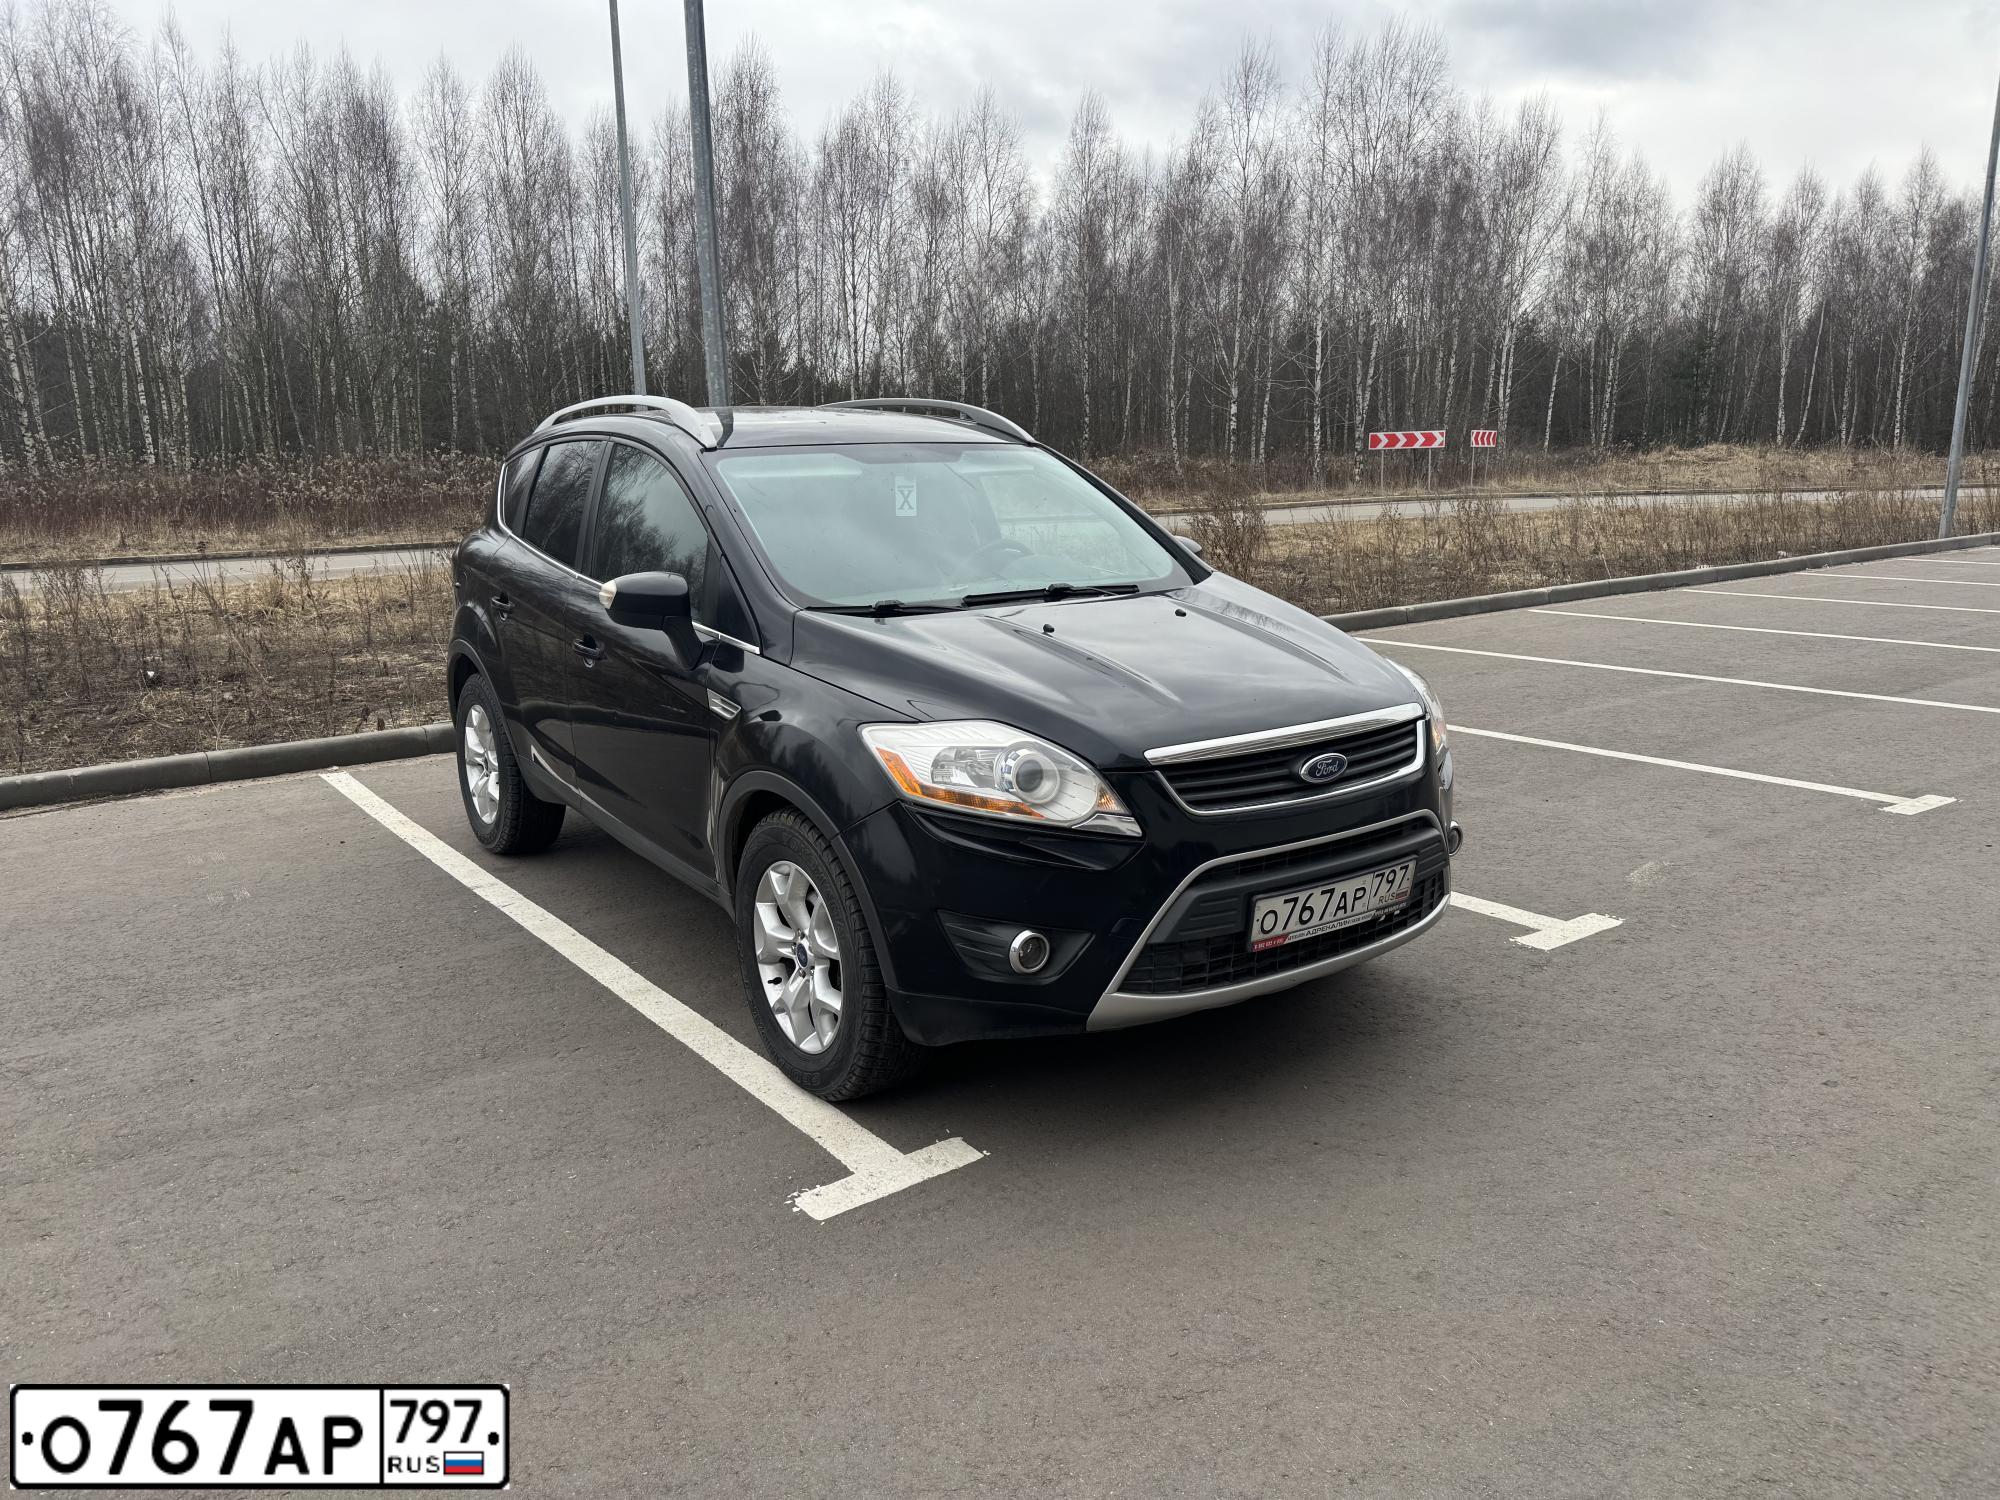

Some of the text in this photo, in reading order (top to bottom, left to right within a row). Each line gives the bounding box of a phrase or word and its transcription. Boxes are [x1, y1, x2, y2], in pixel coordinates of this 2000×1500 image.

[1315, 759, 1339, 777] Ford
[1374, 864, 1409, 897] 797
[1378, 892, 1396, 905] RUS
